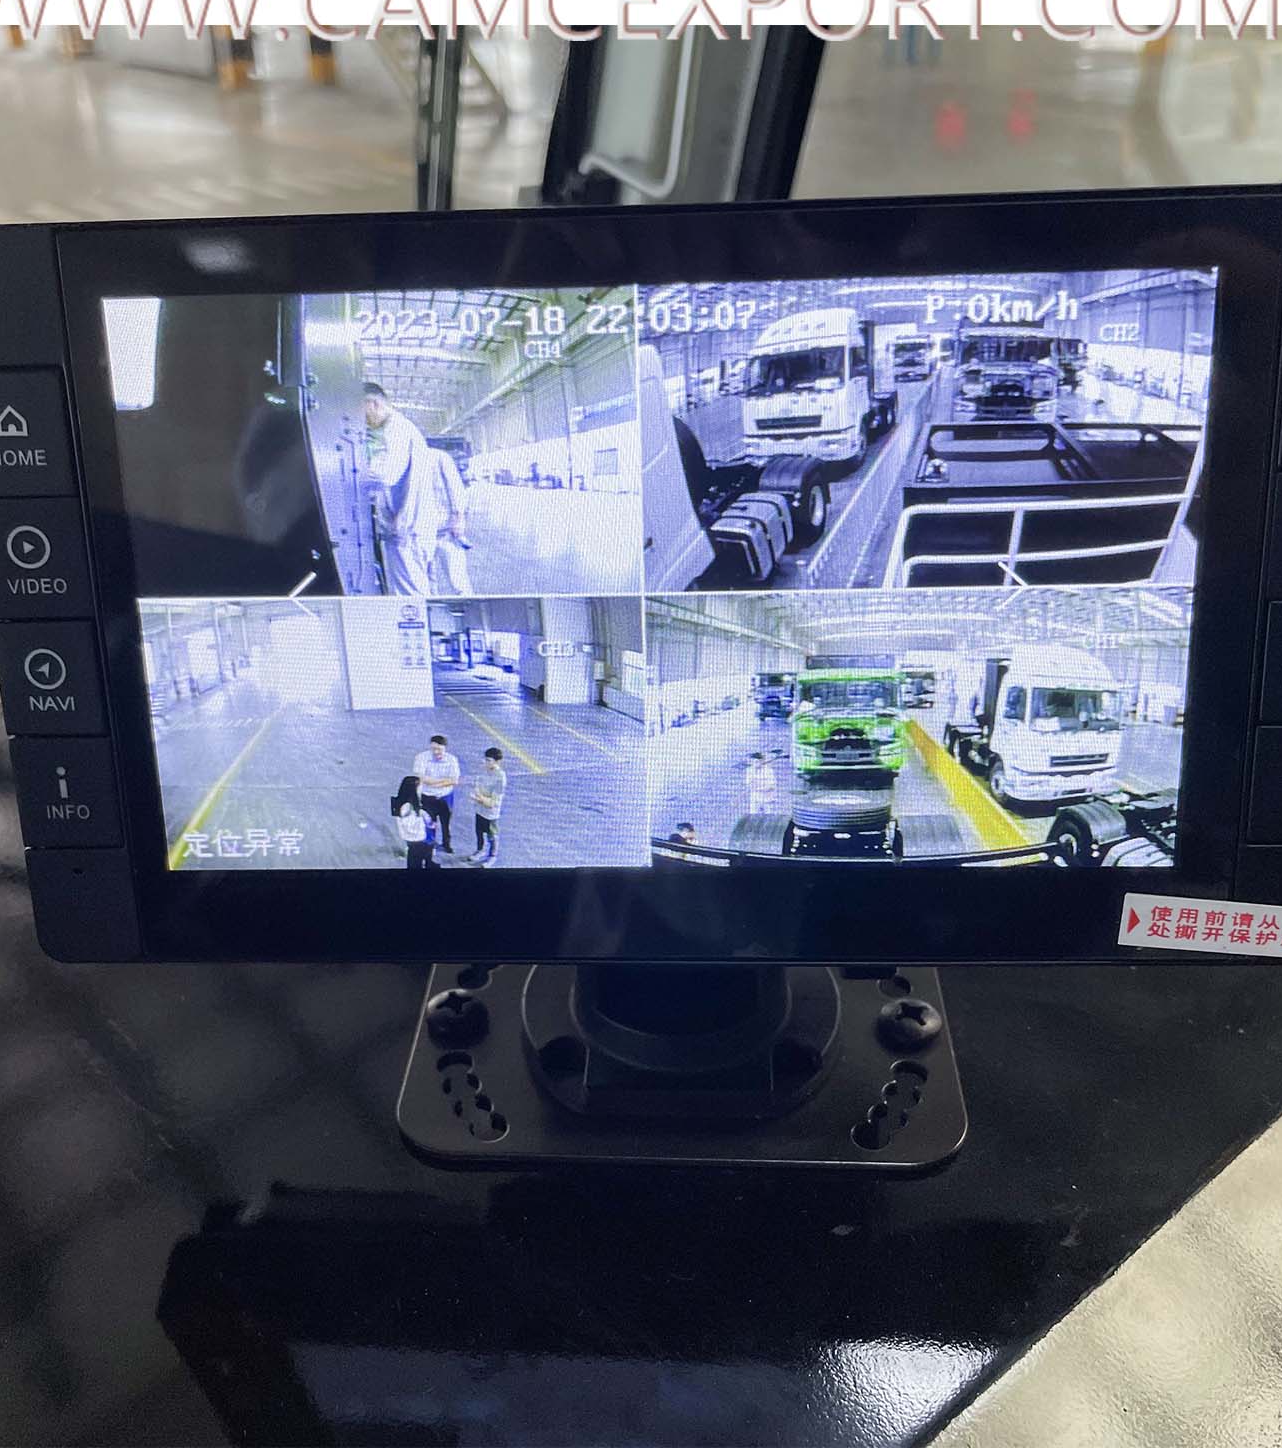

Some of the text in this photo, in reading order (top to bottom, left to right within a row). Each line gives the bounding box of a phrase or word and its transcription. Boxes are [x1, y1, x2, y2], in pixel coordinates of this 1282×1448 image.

[356, 301, 756, 339] 2023-07-18 22:03:07
[1099, 323, 1140, 342] CH2
[523, 338, 562, 360] CH4
[7, 578, 68, 595] VIDEO
[28, 695, 76, 712] NAVI
[46, 804, 91, 820] INFO
[181, 828, 304, 859] 定位异常
